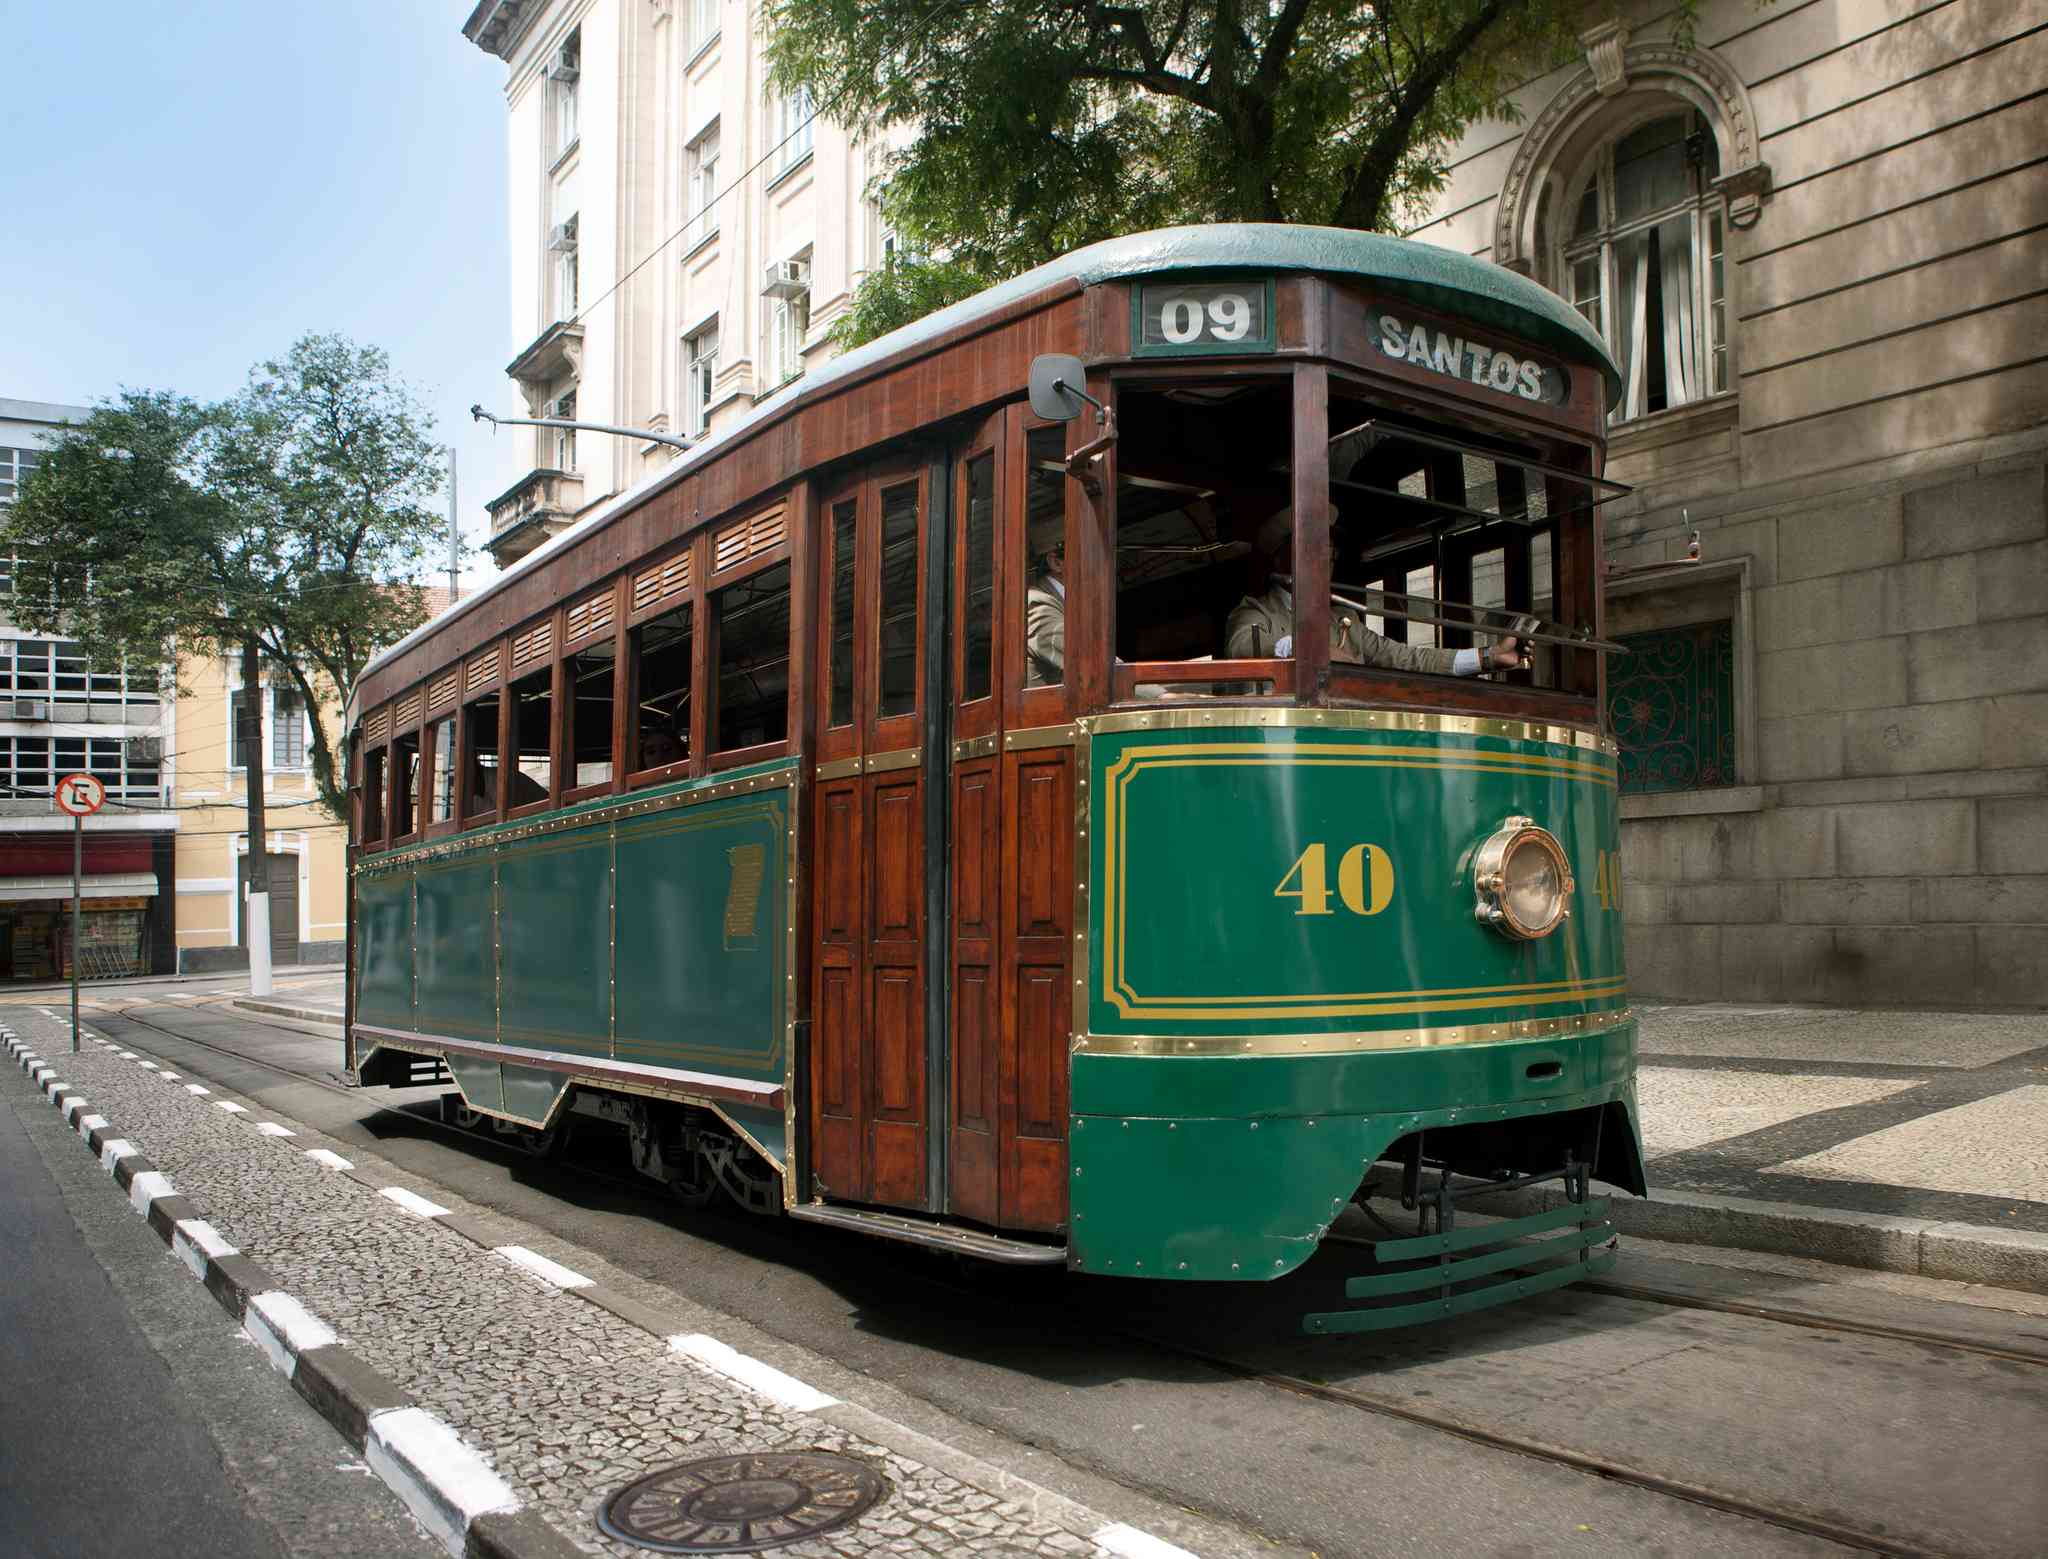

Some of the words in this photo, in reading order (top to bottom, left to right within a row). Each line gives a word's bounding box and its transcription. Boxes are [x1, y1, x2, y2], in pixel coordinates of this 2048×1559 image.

[1161, 293, 1251, 344] 09
[1378, 314, 1545, 401] SANTOS
[1273, 842, 1395, 916] 40
